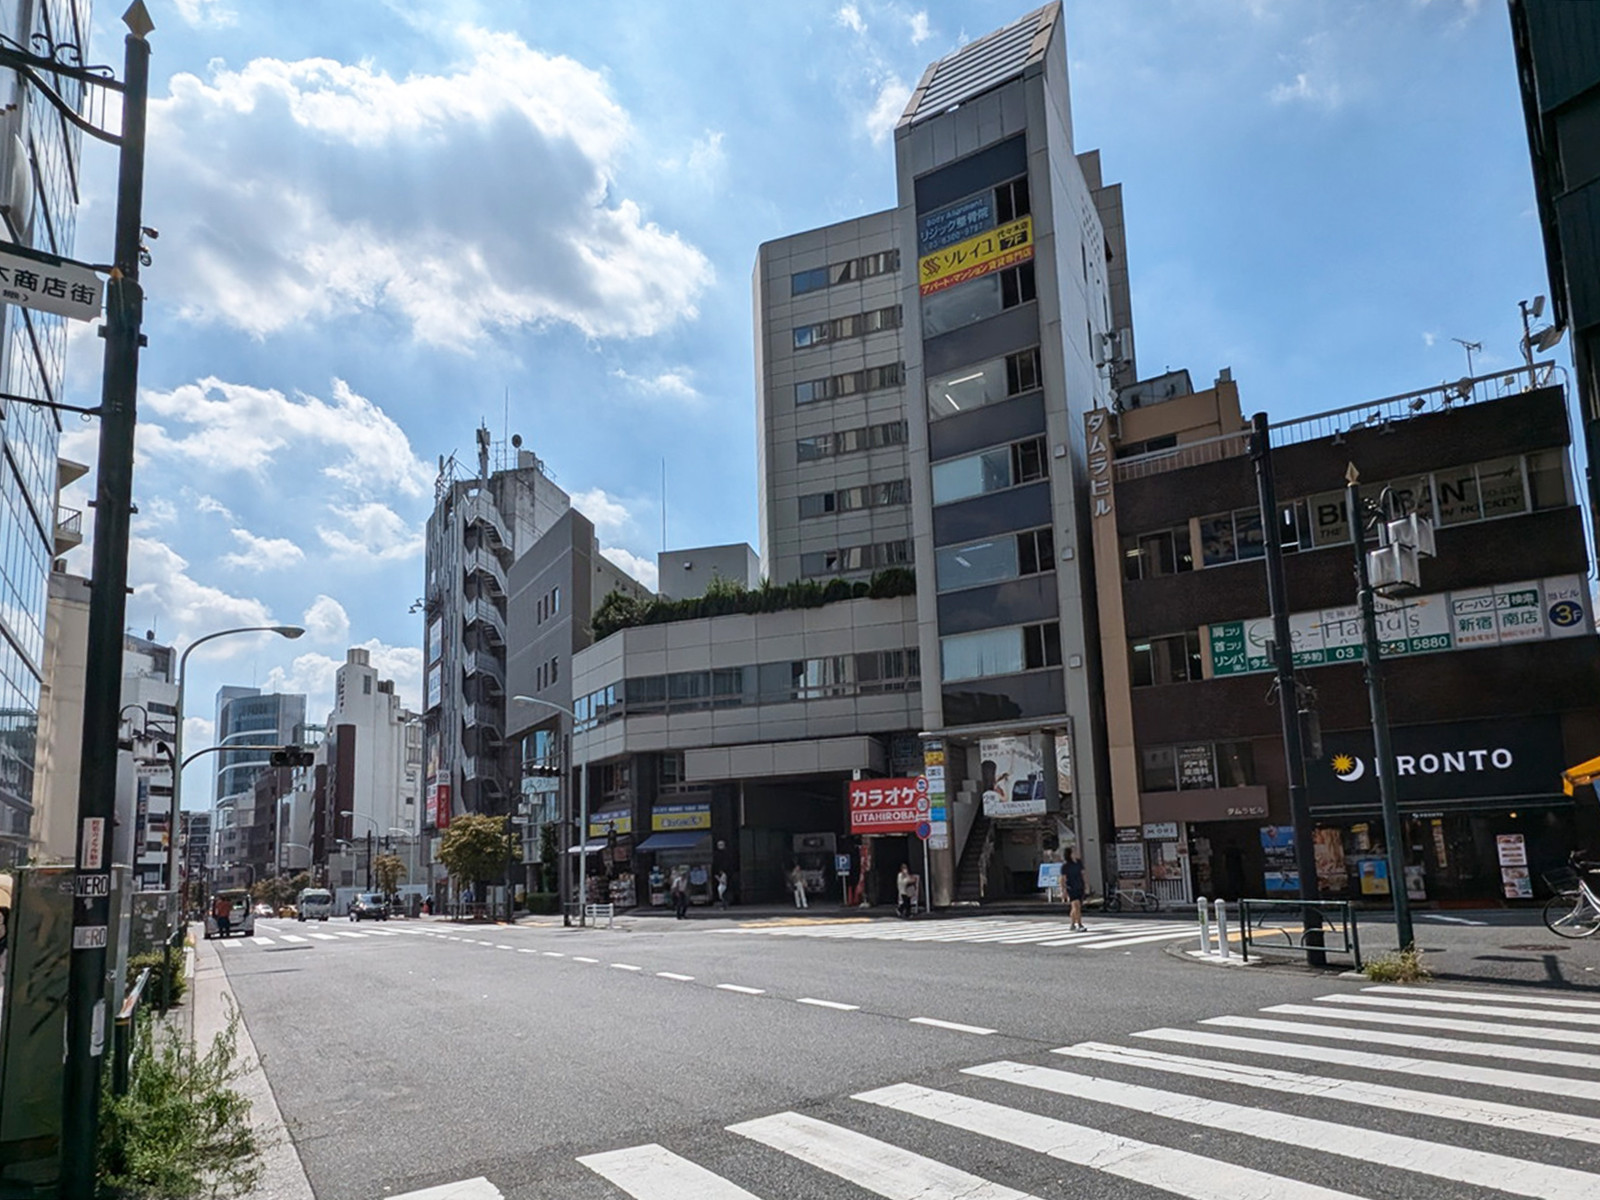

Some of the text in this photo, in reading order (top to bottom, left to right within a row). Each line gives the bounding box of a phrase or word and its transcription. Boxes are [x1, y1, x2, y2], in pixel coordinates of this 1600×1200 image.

[1005, 234, 1023, 247] 7F
[1087, 414, 1112, 517] タムラビル
[1555, 604, 1582, 624] 3F
[1214, 641, 1242, 653] 首コリ
[1335, 647, 1355, 659] 03
[1413, 636, 1448, 650] 5880
[852, 786, 916, 808] カラオケ
[855, 811, 915, 822] UTAHIROBA
[839, 856, 847, 870] P
